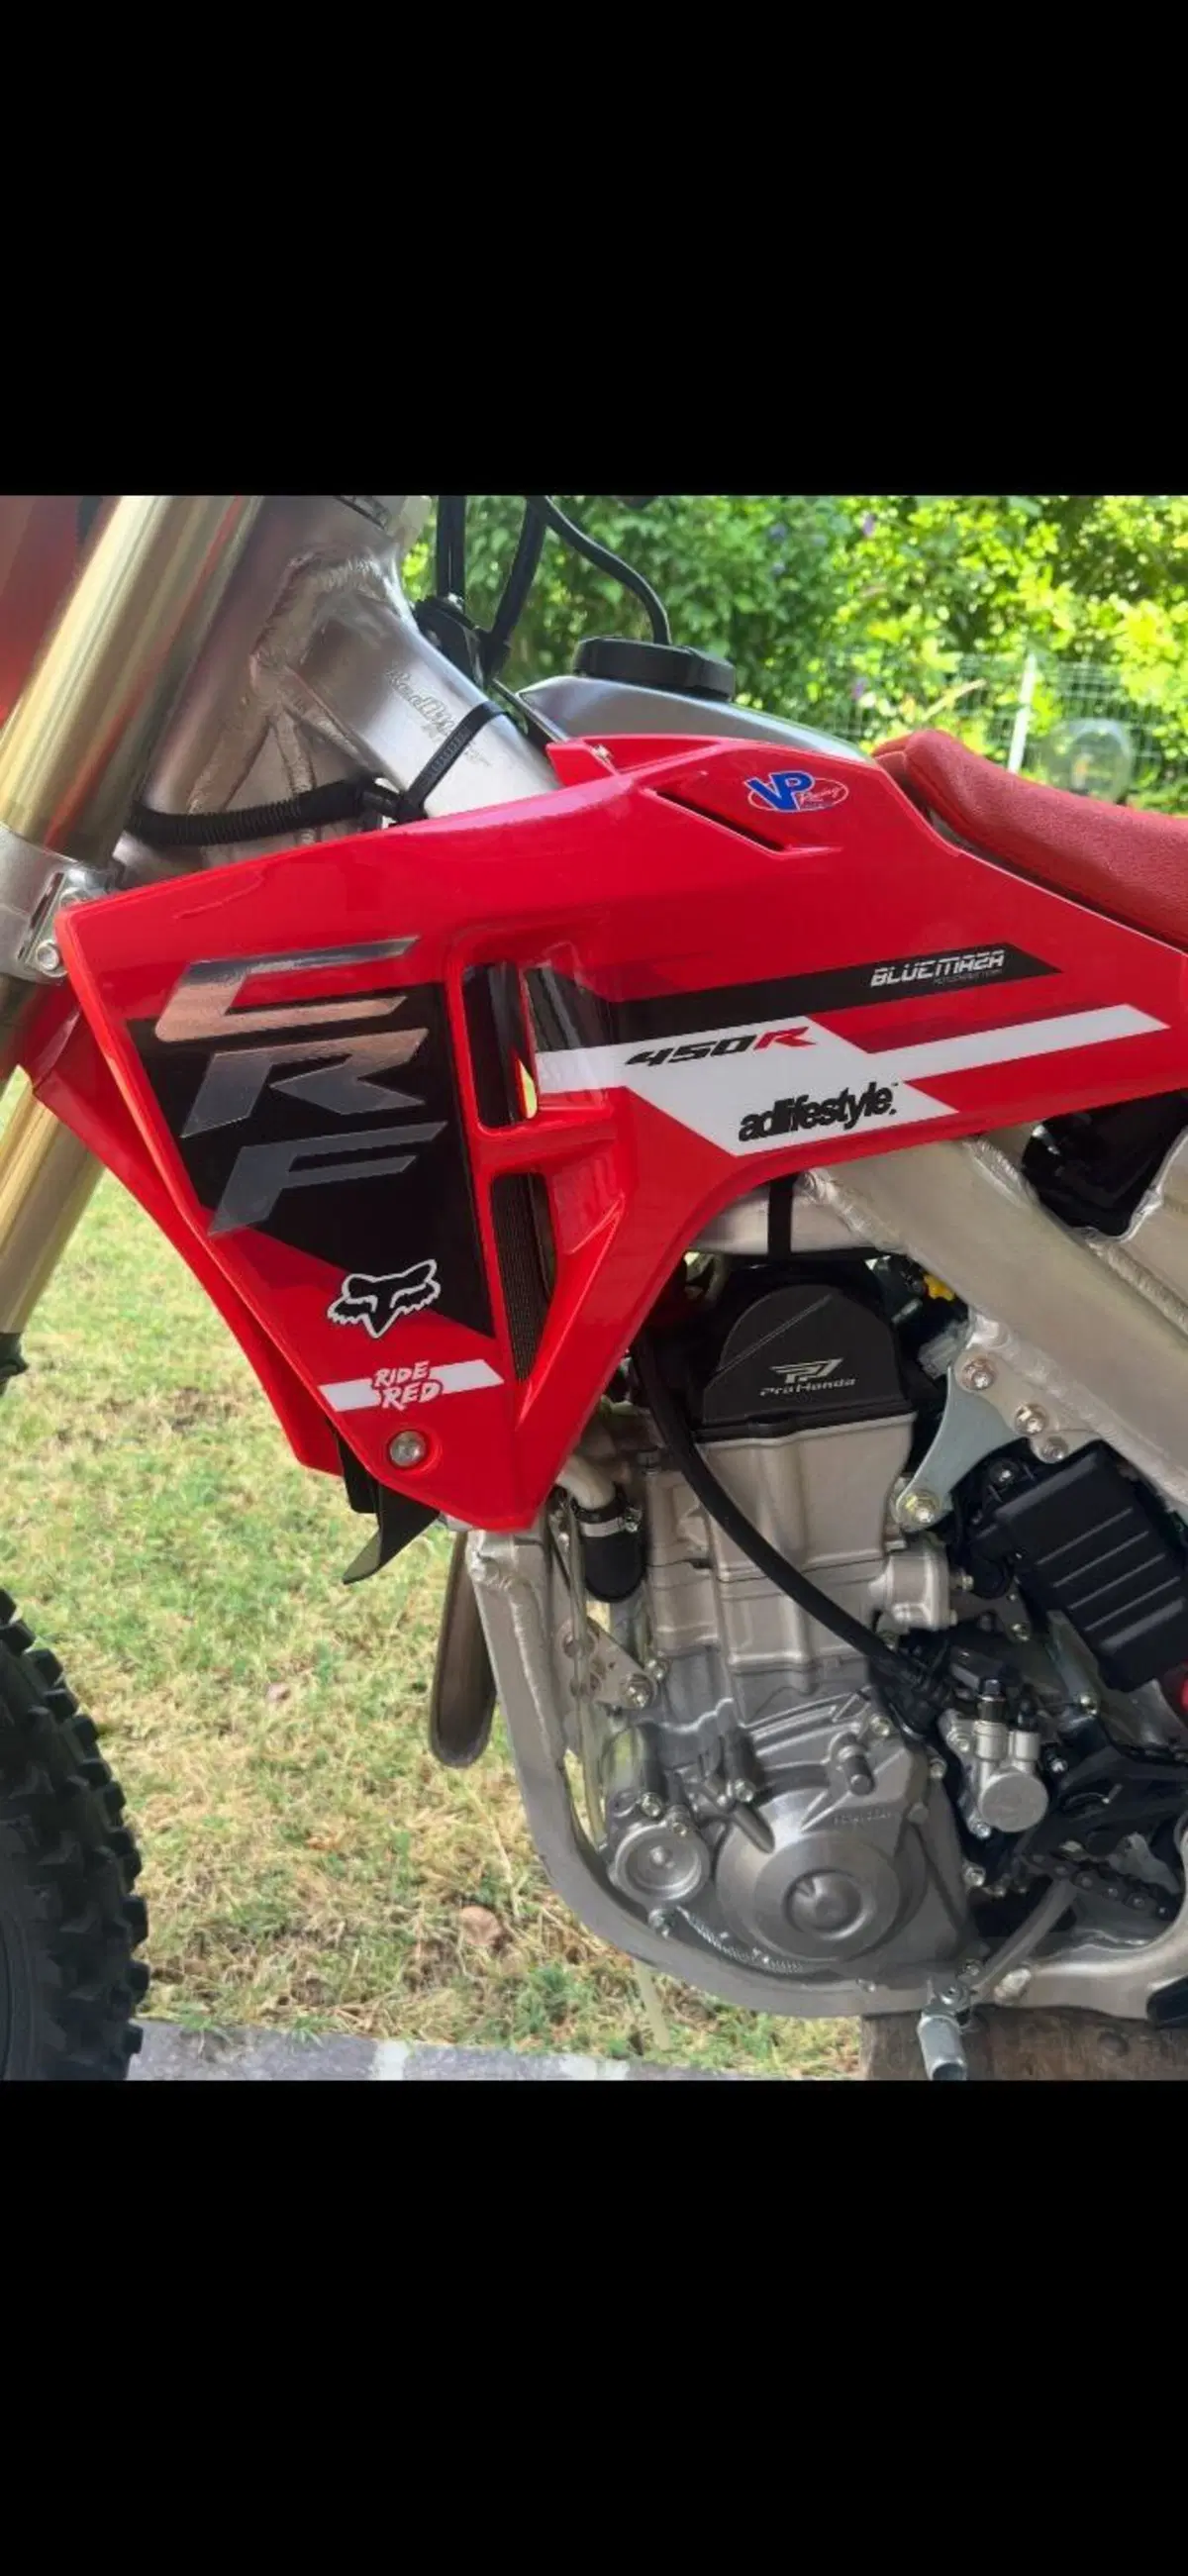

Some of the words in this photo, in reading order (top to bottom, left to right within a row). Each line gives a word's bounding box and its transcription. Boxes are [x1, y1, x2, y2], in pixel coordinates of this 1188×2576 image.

[743, 771, 815, 812] VP
[625, 1027, 817, 1066] 450R
[154, 936, 447, 1237] CRF
[373, 1360, 430, 1387] RIDE
[381, 1382, 441, 1411] RED
